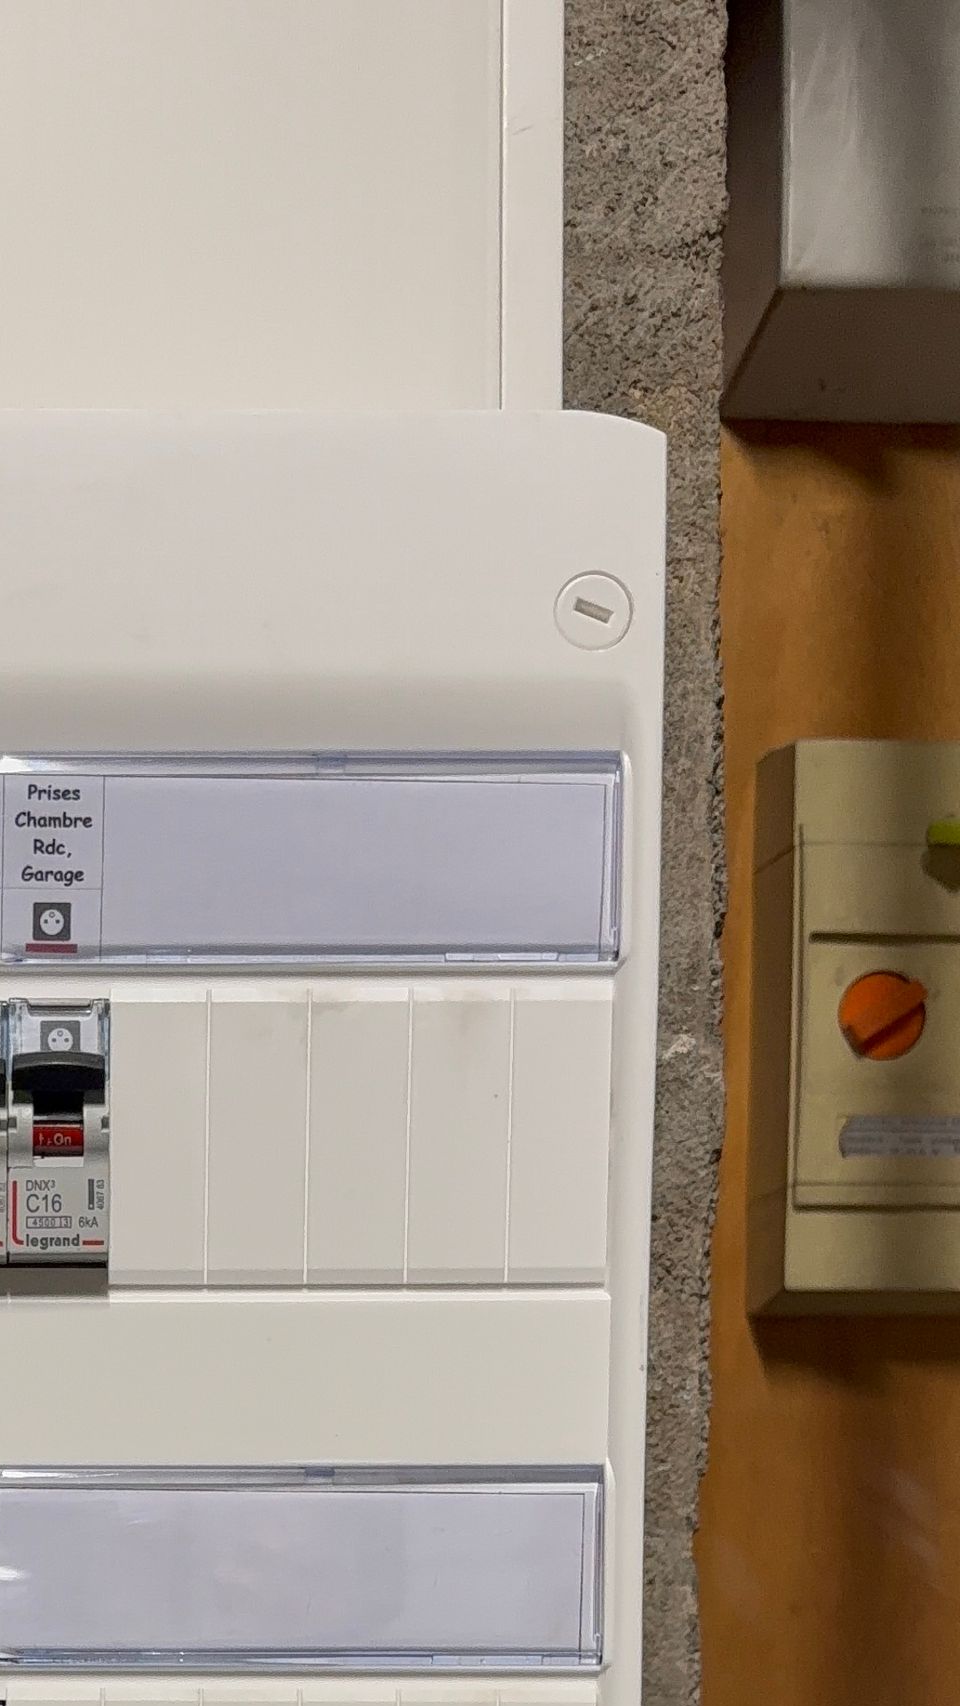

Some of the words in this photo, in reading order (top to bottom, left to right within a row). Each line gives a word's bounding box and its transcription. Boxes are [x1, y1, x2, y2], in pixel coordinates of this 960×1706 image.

[28, 785, 80, 801] Prises
[15, 813, 92, 829] Chambre
[33, 839, 72, 858] Rdc,
[21, 867, 84, 886] Garage
[26, 1194, 62, 1213] C16
[79, 1217, 98, 1227] 6kA
[26, 1234, 79, 1249] legrand
